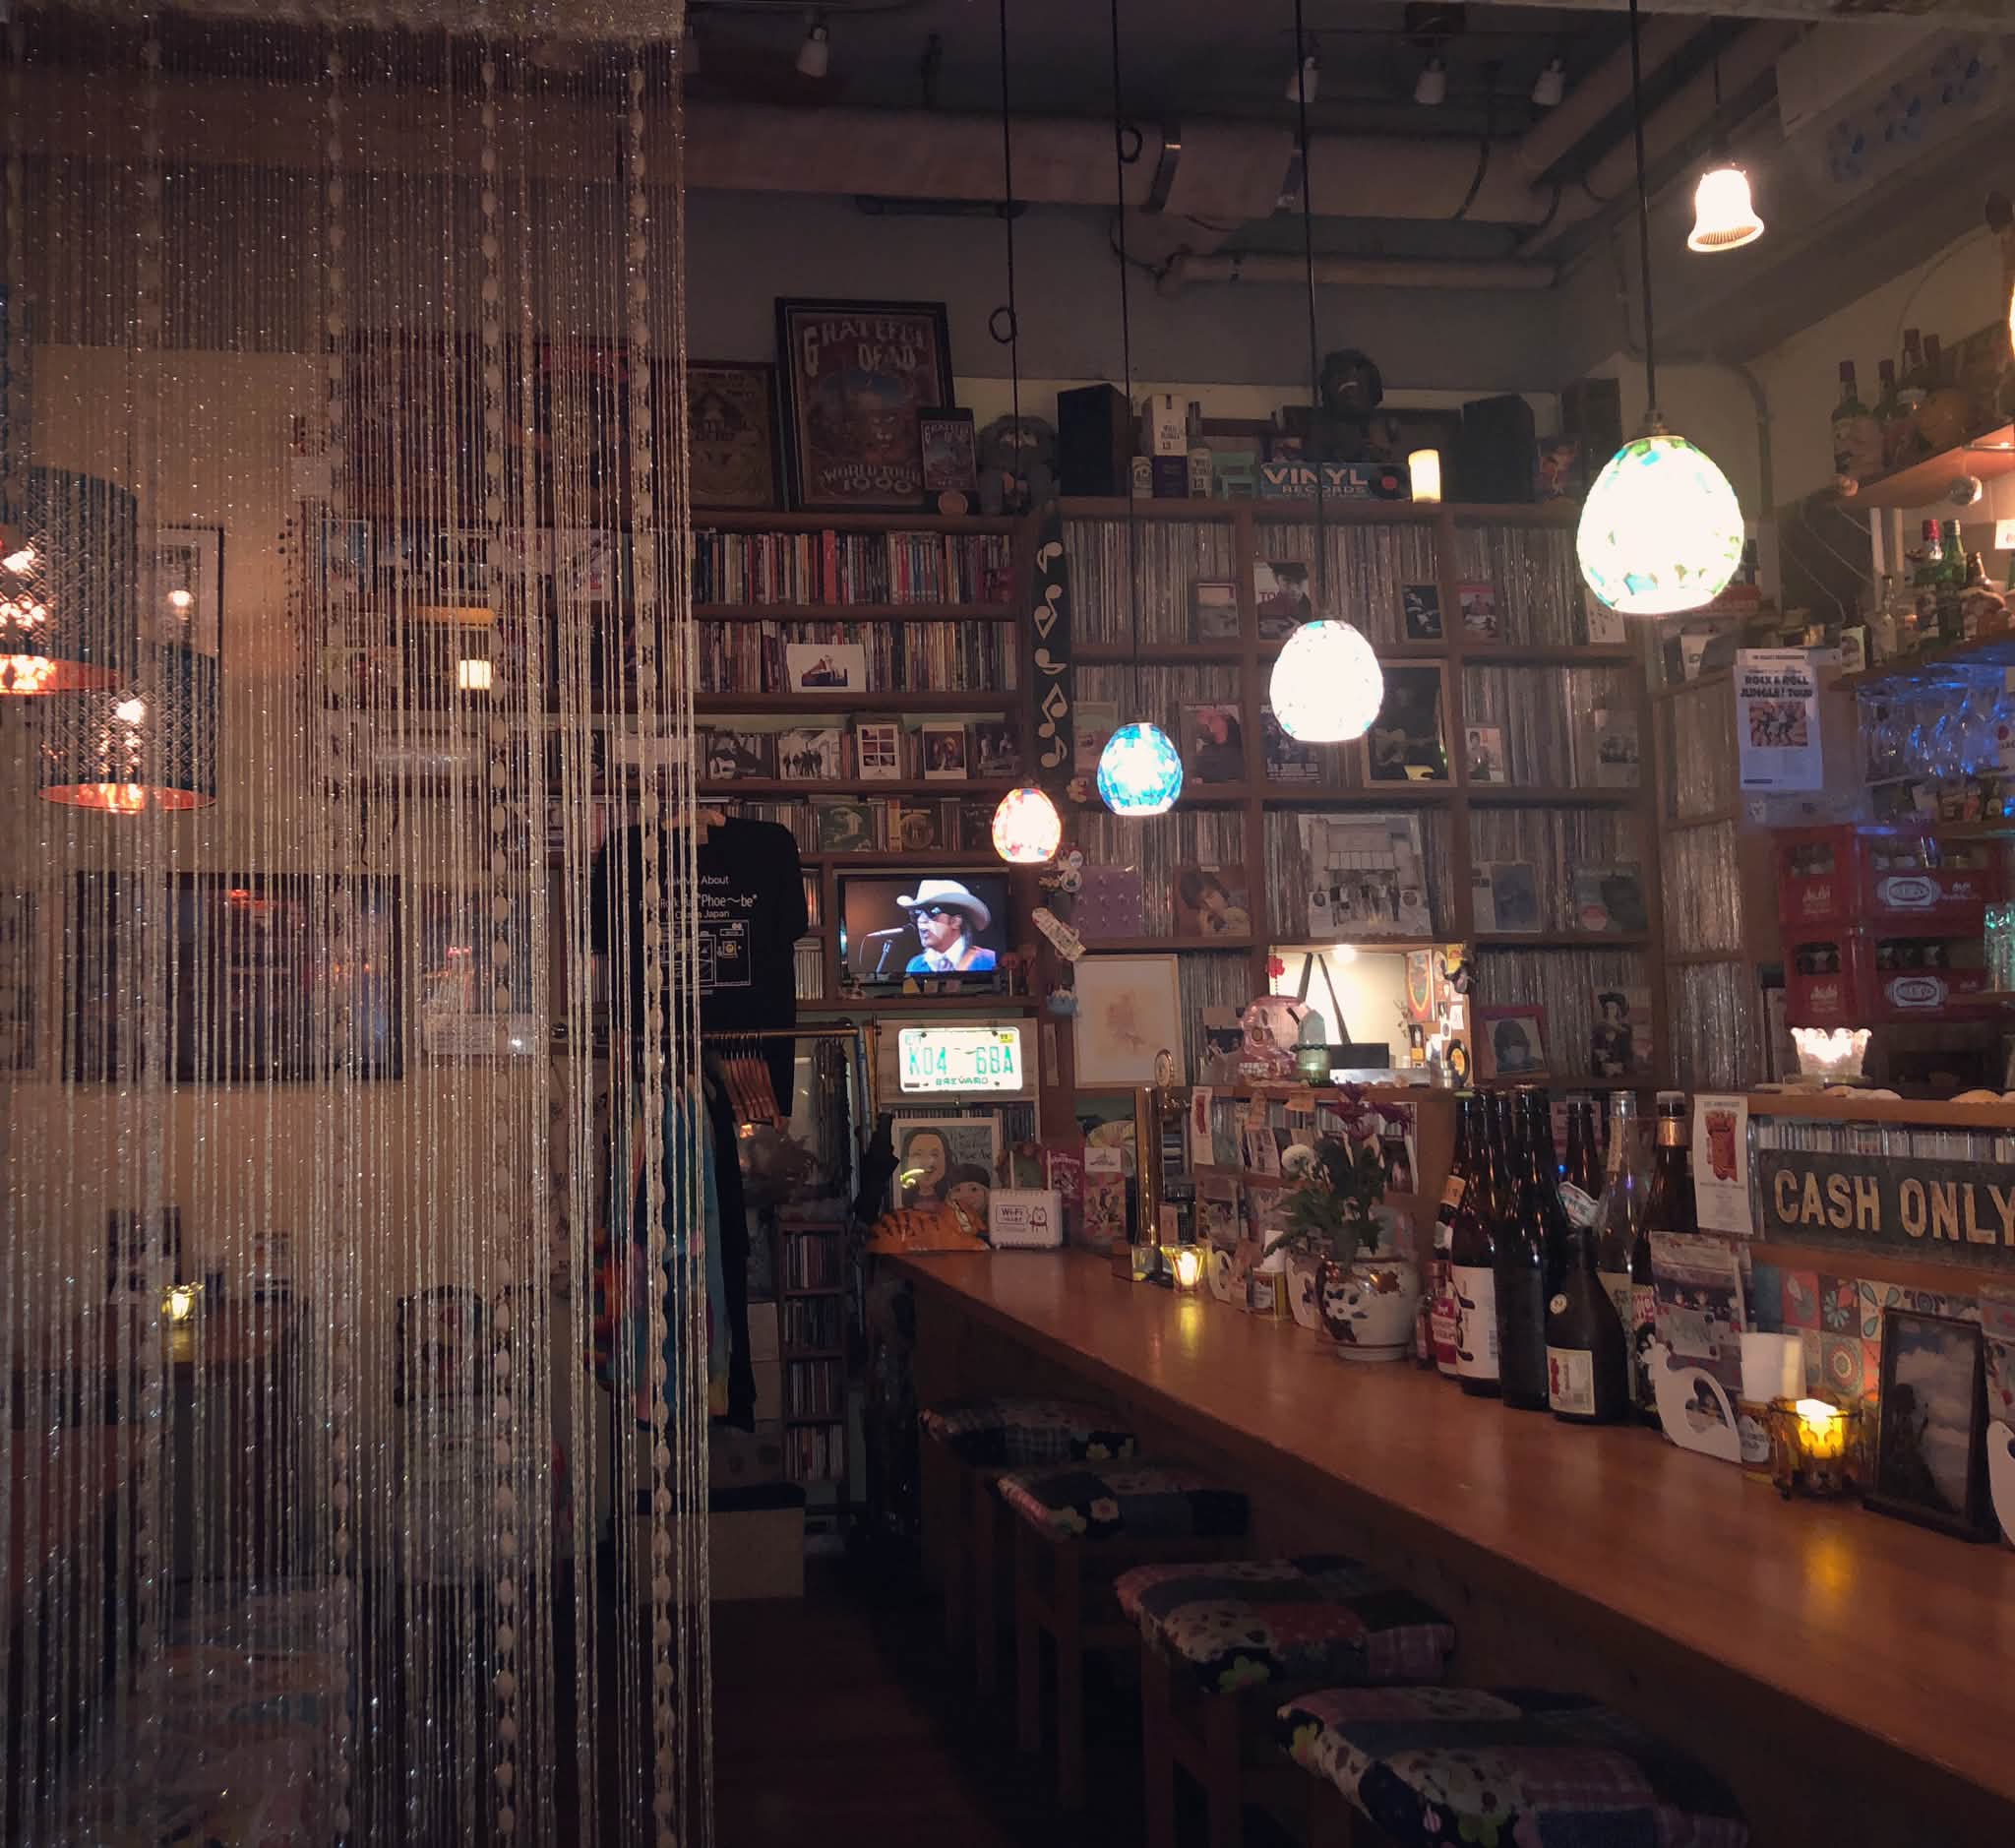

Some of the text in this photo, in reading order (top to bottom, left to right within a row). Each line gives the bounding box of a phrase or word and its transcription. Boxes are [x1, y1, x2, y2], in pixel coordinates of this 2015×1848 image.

[1262, 467, 1369, 485] VINYL
[702, 875, 730, 885] About
[936, 1077, 989, 1086] BREVARD
[1774, 1168, 1881, 1232] CASH
[1899, 1178, 2015, 1247] ONLY
